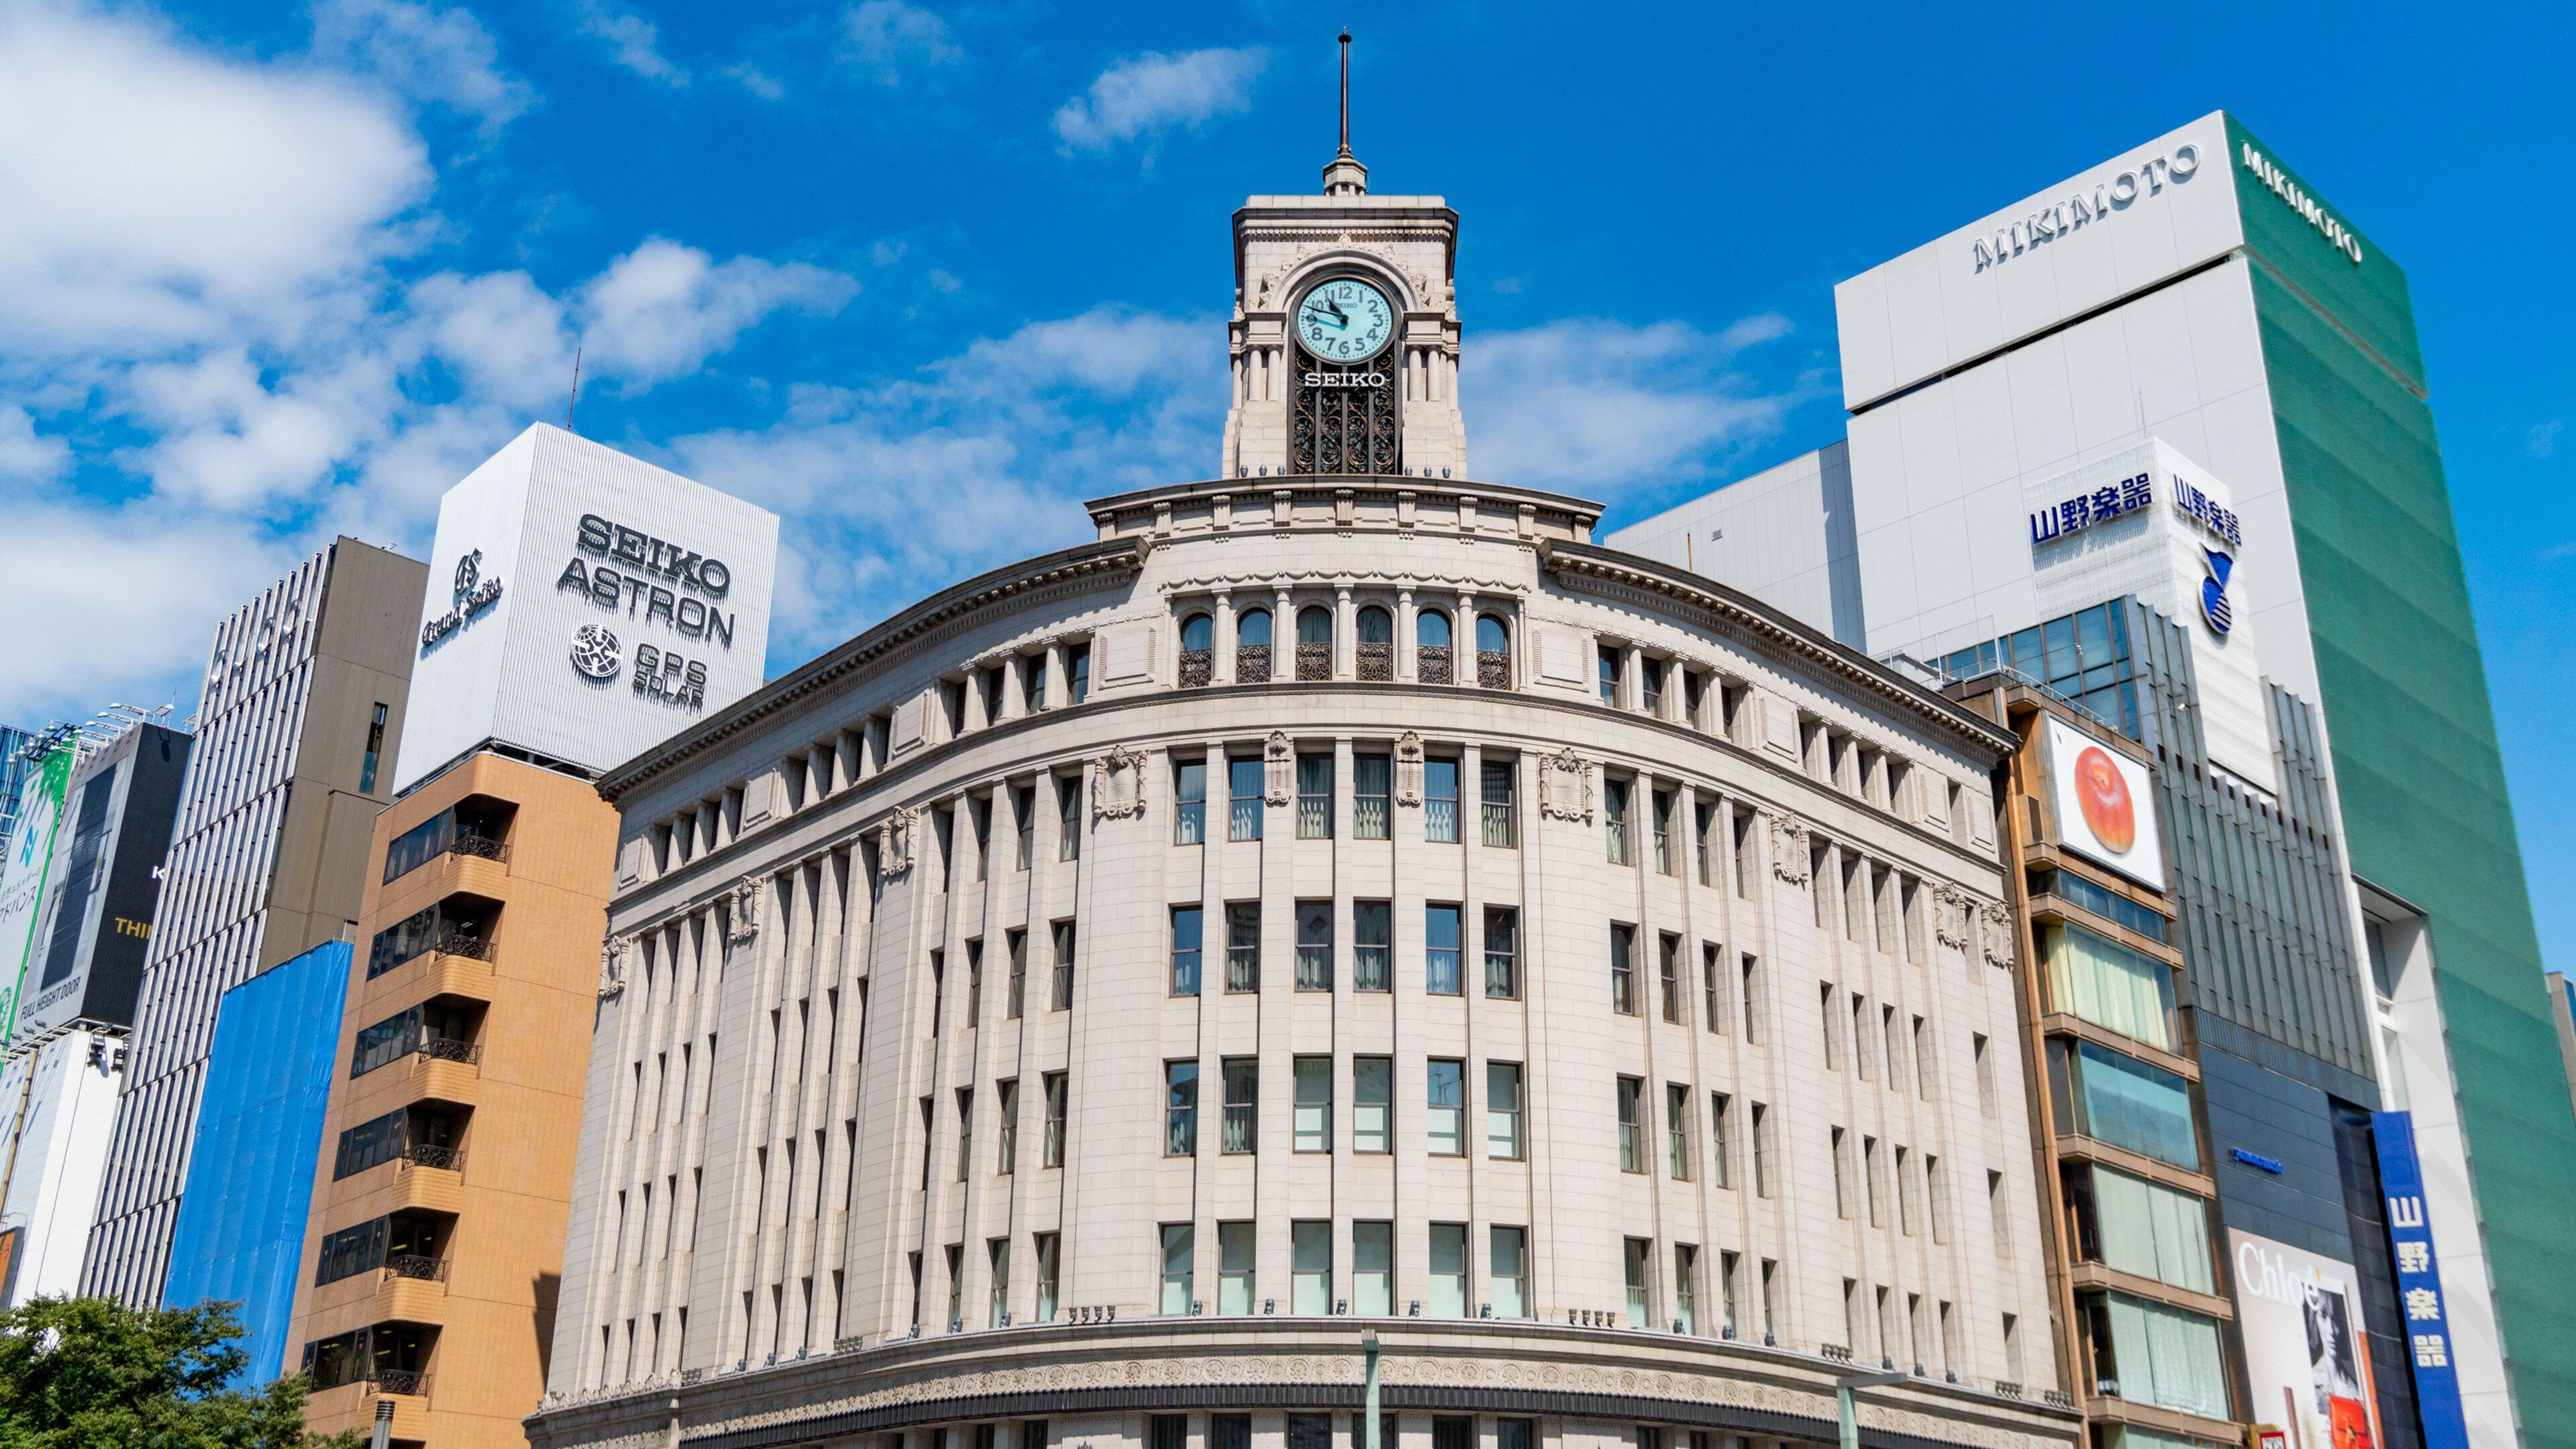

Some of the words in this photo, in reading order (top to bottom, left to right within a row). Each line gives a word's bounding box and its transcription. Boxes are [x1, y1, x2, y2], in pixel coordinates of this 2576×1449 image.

[1974, 144, 2200, 270] MIKIMOTO
[2241, 139, 2362, 263] MIKIMOTO
[1325, 290, 1335, 302] 11
[1338, 286, 1352, 299] 12
[1358, 290, 1362, 303] 1
[1367, 300, 1379, 313] 2
[1311, 327, 1323, 341] 8
[1366, 328, 1379, 341] 4
[1373, 314, 1384, 327] 3
[1325, 337, 1336, 351] 7
[1338, 341, 1350, 355] 6
[1354, 337, 1365, 351] 5
[1304, 372, 1386, 388] SEIKO
[2030, 472, 2153, 545] 山野楽器
[2174, 473, 2242, 547] 山野楽器
[578, 513, 731, 594] SEIKO
[422, 600, 468, 646] Grand
[463, 576, 504, 617] Seiko
[557, 556, 735, 643] ASTRON
[635, 643, 707, 686] GPS
[633, 669, 704, 705] SOLAR
[20, 1002, 38, 1022] FULL
[36, 986, 61, 1014] HEIGHT
[60, 977, 80, 999] DOOR
[2238, 1241, 2320, 1311] Chloé
[2389, 1196, 2448, 1367] 山野楽器
